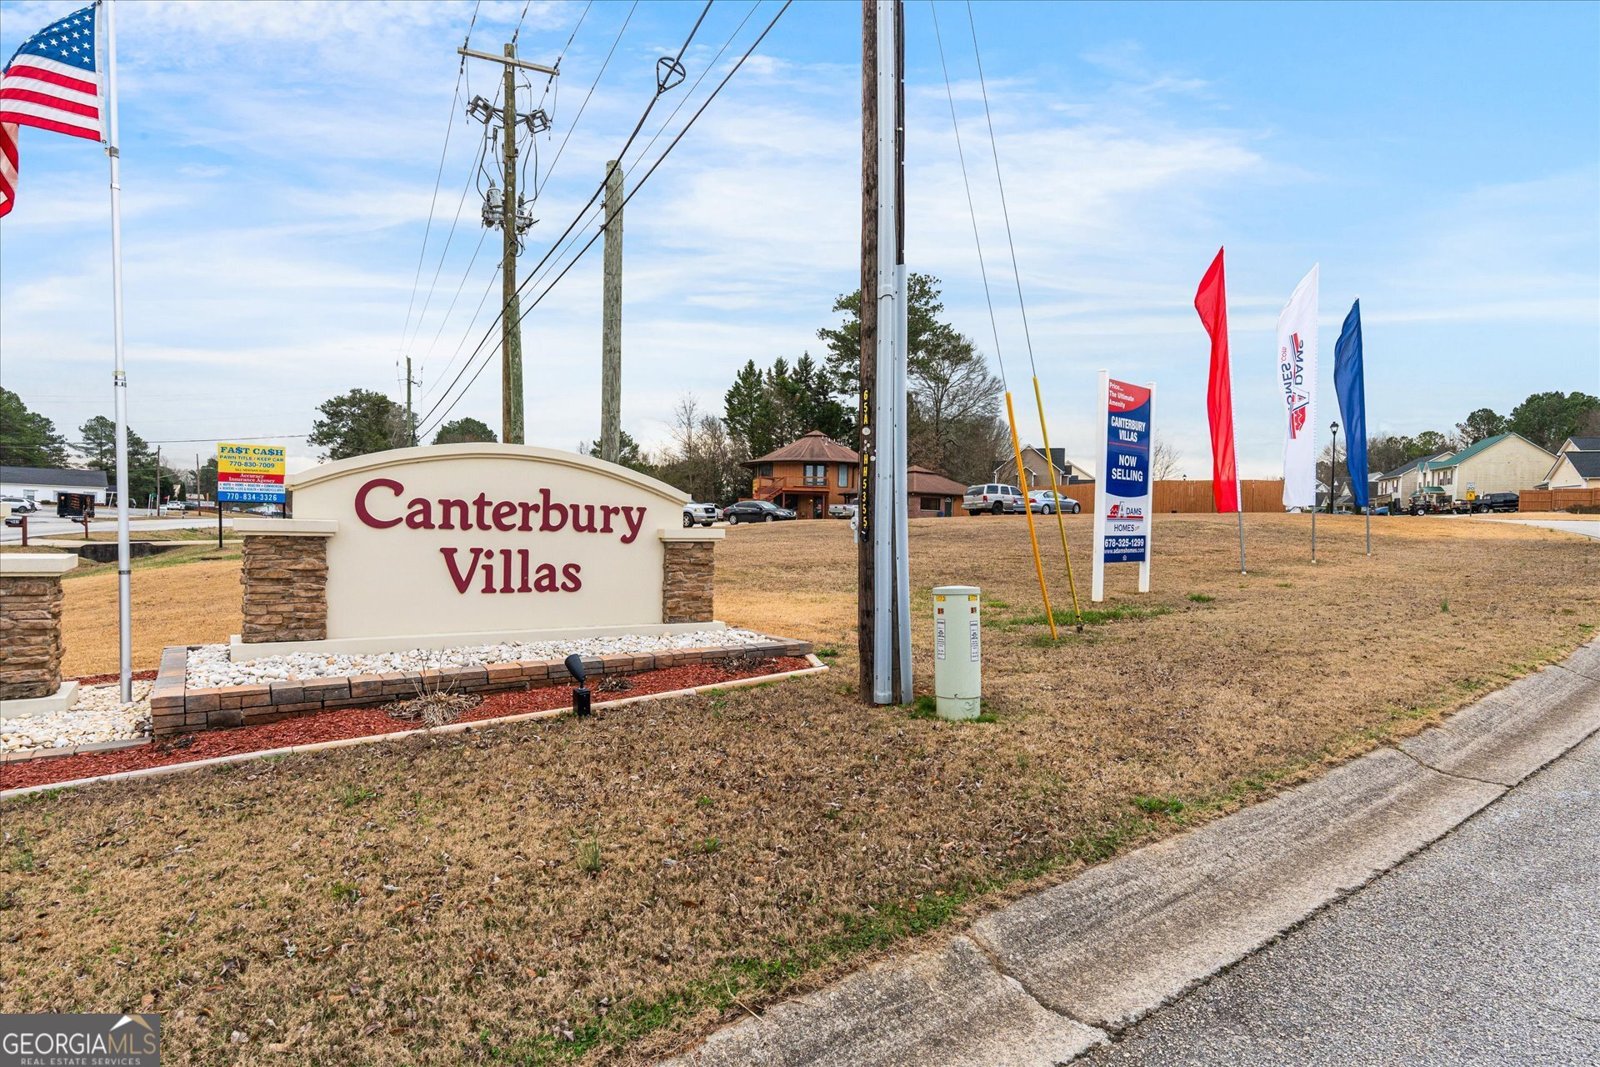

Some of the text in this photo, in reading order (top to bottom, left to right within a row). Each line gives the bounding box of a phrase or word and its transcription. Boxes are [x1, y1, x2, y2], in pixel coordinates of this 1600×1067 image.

[1109, 390, 1117, 398] The
[1109, 399, 1126, 410] Amenity
[1111, 415, 1146, 432] CANTERBURY
[1119, 430, 1138, 443] VILLAS
[220, 446, 283, 456] FA$T CA$H
[1118, 454, 1137, 467] NOW
[1111, 468, 1144, 482] SELLING
[226, 493, 277, 501] 770-834-3326
[354, 478, 647, 544] Canterbury
[1113, 524, 1135, 532] HOMES
[1104, 538, 1144, 548] 678-325-1299
[439, 547, 582, 594] Villas
